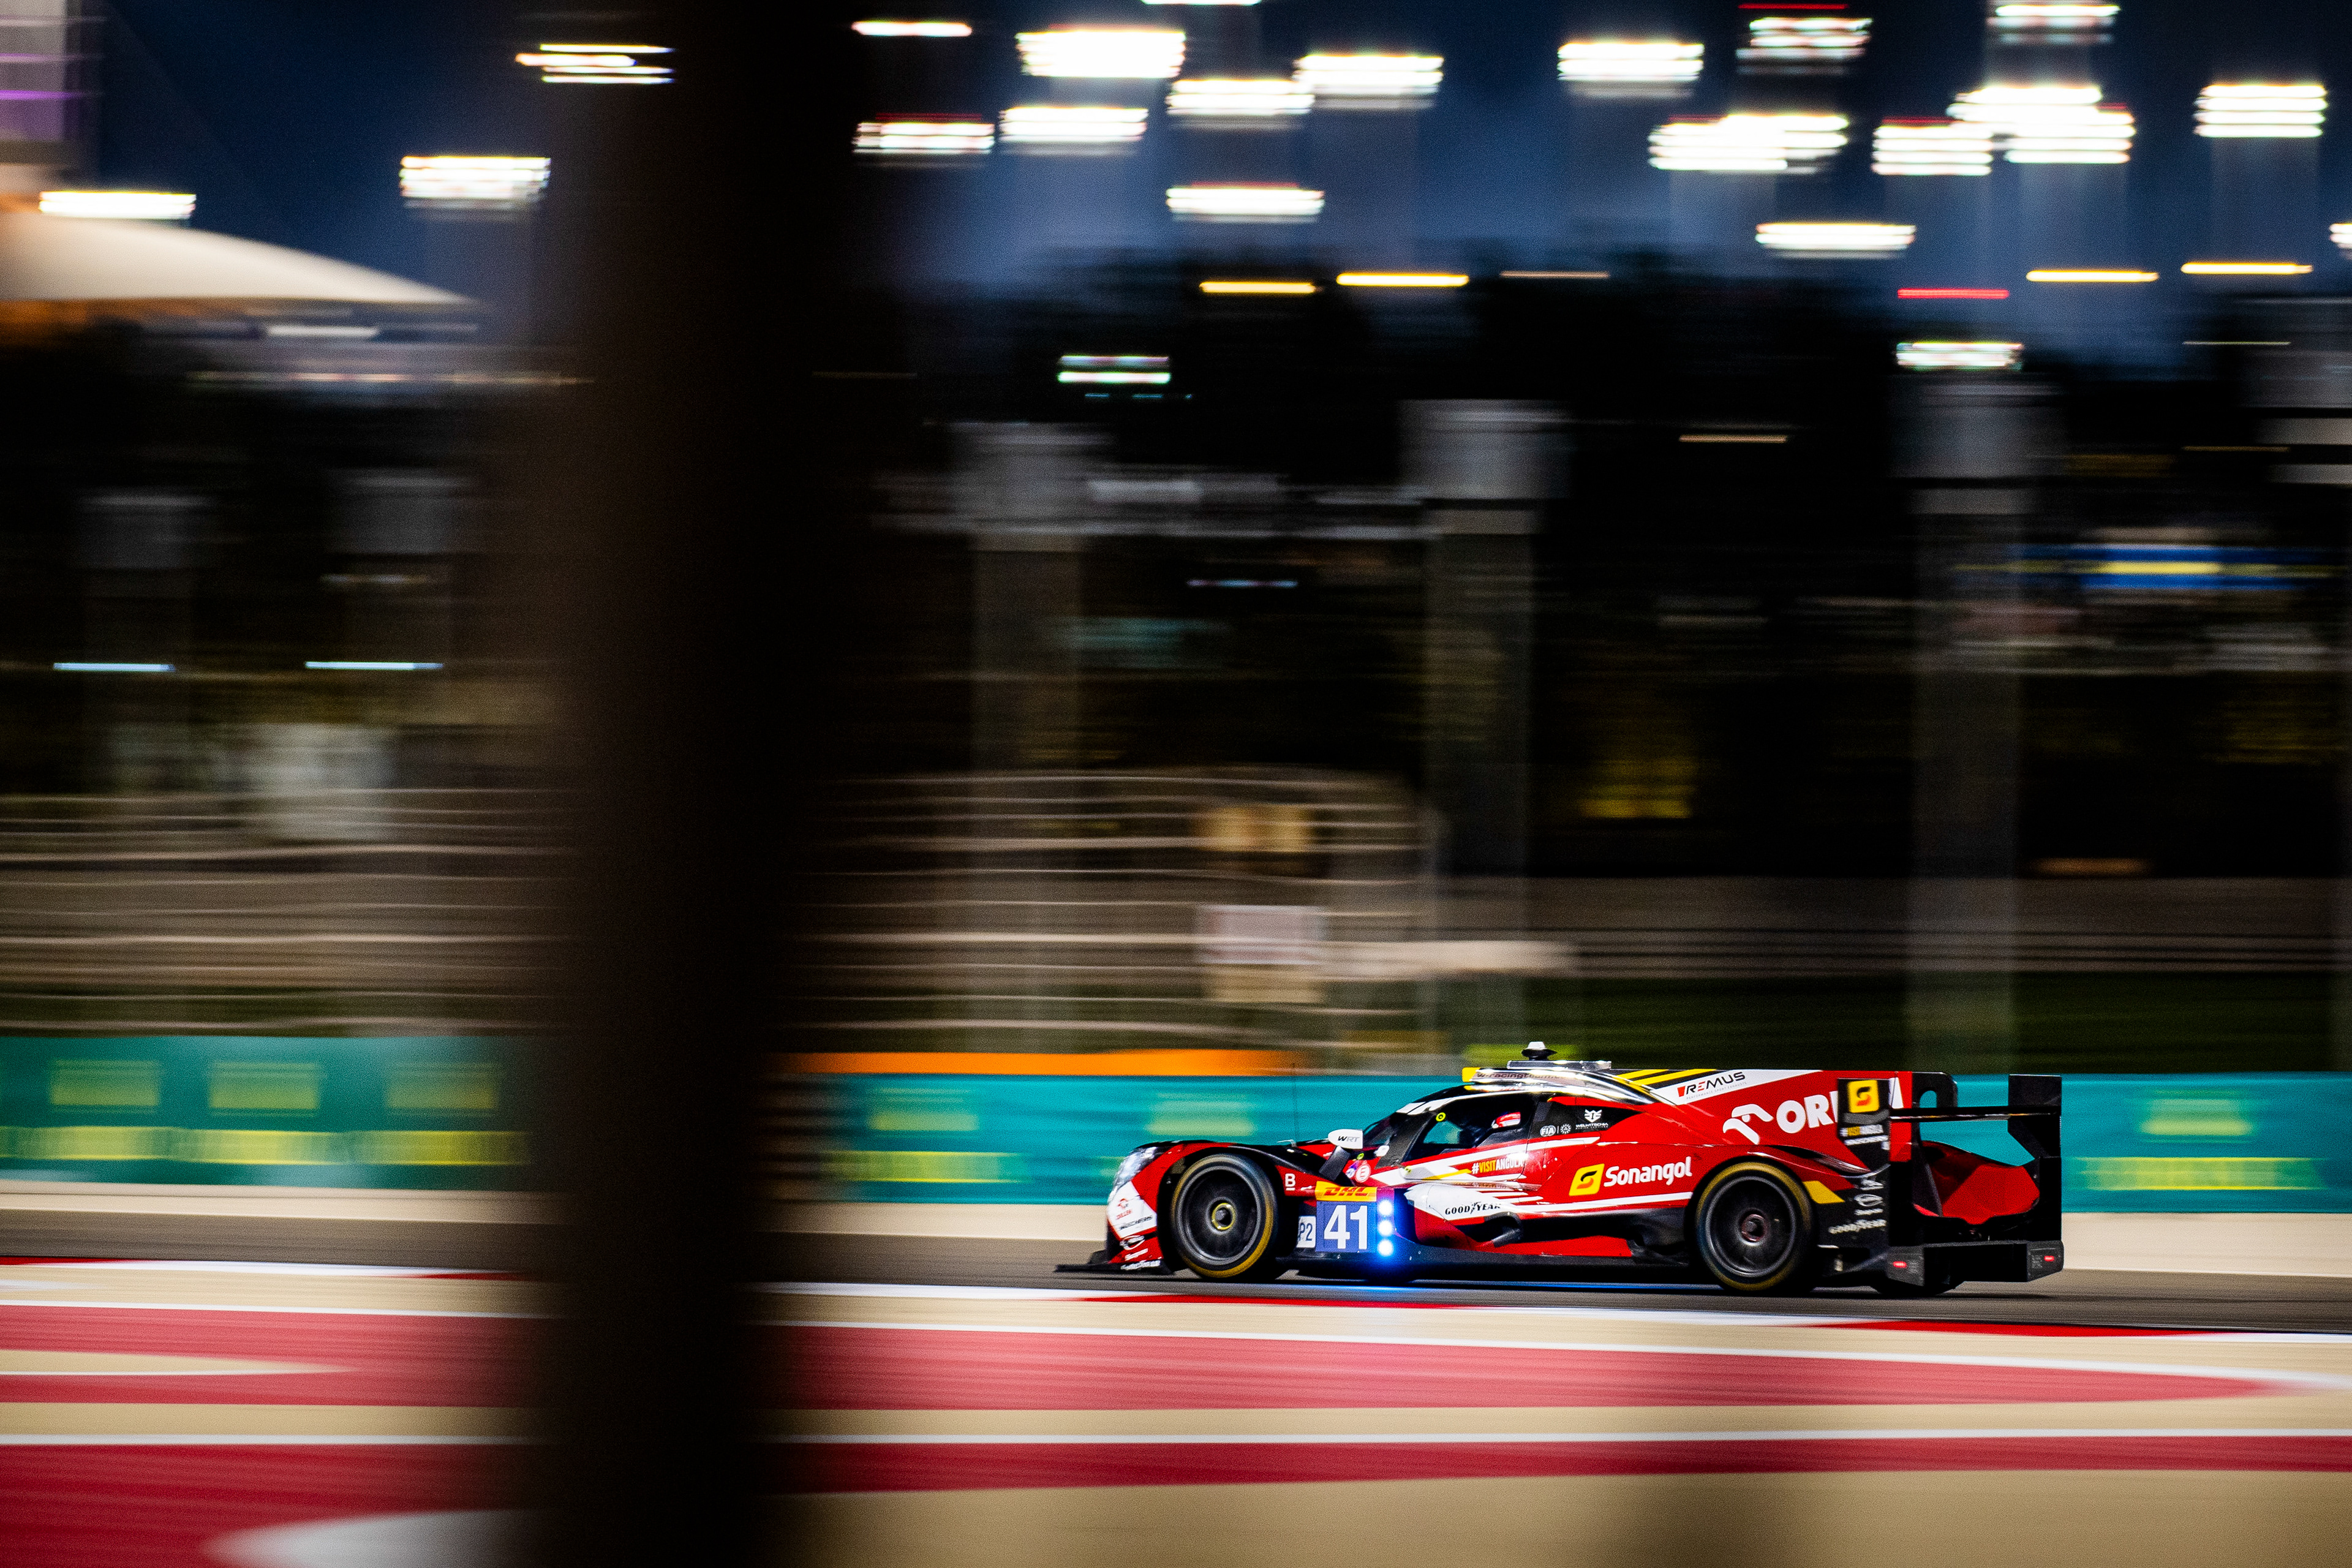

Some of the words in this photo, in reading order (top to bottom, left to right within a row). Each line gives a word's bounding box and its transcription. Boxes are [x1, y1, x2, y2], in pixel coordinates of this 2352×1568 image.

[1686, 1071, 1746, 1095] REMUS
[1540, 1126, 1555, 1136] FIA
[1285, 1173, 1296, 1187] B
[1604, 1156, 1692, 1187] Sonangol
[1324, 1187, 1369, 1196] DHL
[1298, 1222, 1313, 1242] P2
[1324, 1204, 1368, 1250] 41
